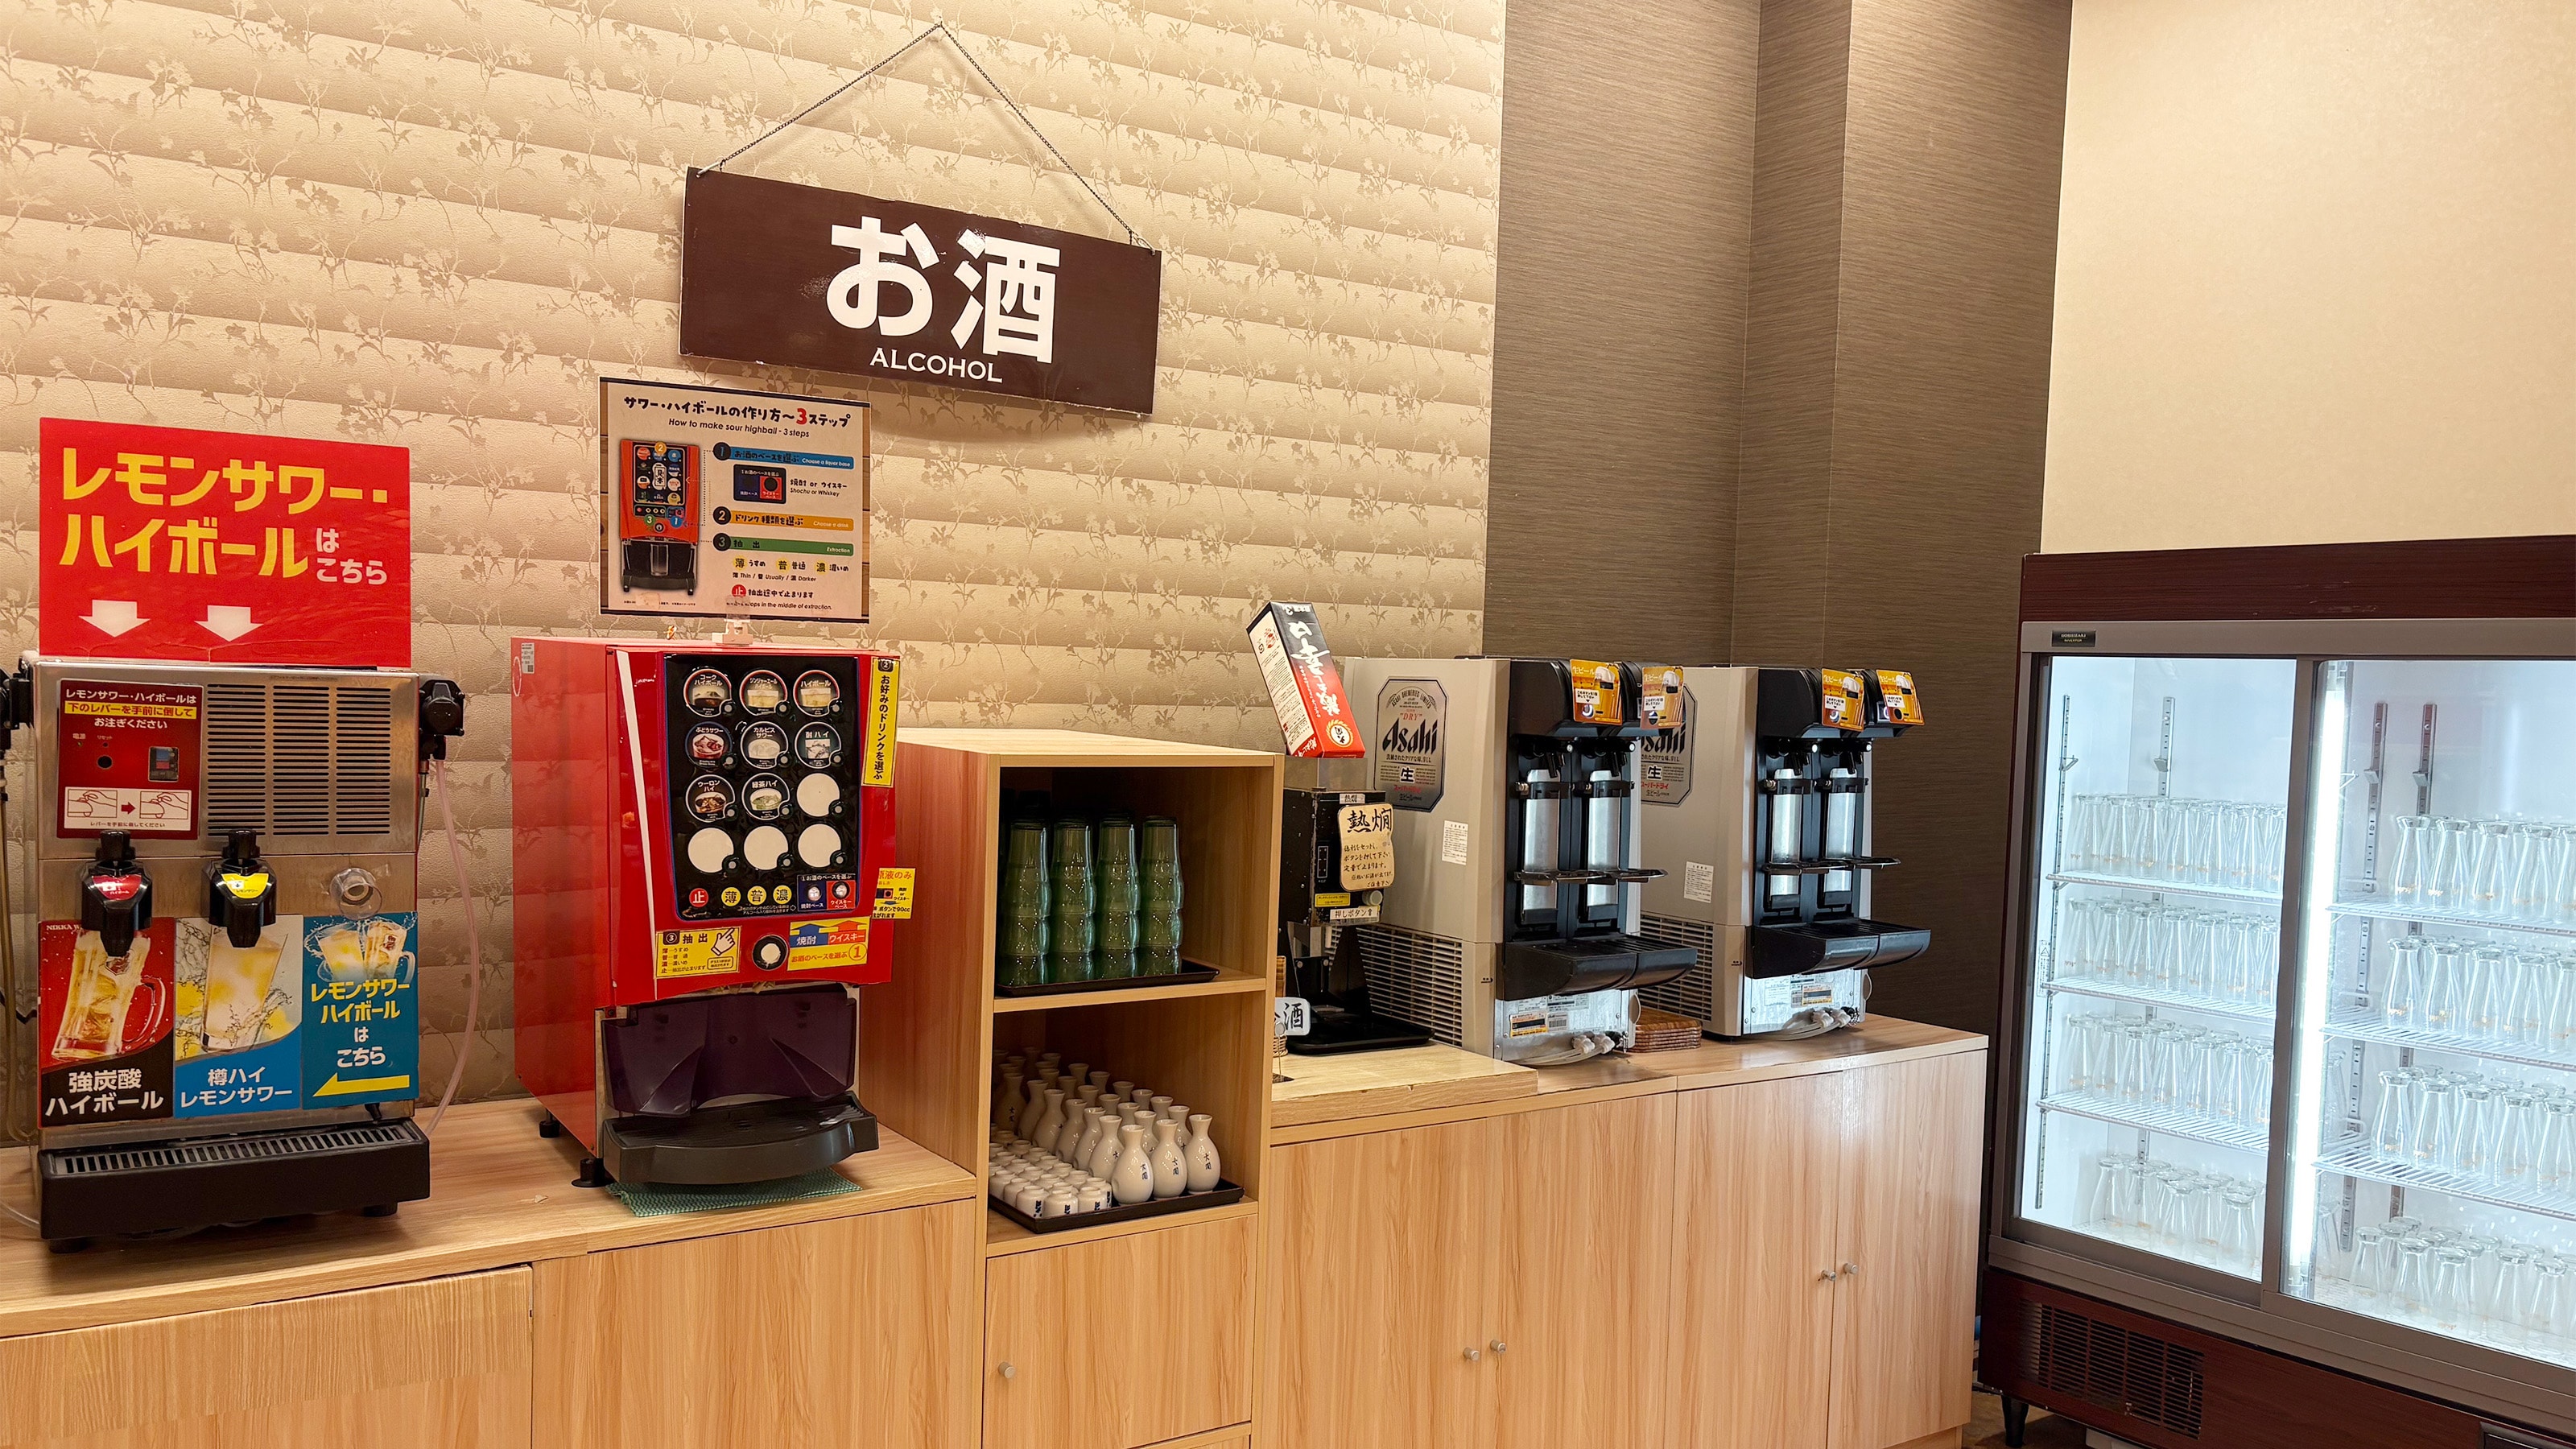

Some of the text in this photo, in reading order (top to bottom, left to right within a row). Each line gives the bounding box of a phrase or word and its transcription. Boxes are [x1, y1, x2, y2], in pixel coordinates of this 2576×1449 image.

[826, 215, 1061, 364] お酒
[870, 347, 1003, 384] ALCOHOL
[669, 419, 687, 427] How
[689, 419, 698, 427] to
[700, 421, 724, 430] make
[745, 424, 778, 435] highball
[789, 430, 810, 438] steps
[734, 451, 799, 464] お酒のベースを選ぶ
[790, 478, 807, 486] 焼酎
[821, 481, 848, 489] ウイスキー
[818, 489, 840, 497] Whiskey
[59, 514, 340, 578] ハイボール は
[735, 558, 745, 568] 薄
[778, 561, 787, 570] 普
[791, 562, 806, 570] 普通
[316, 558, 388, 585] こちら
[748, 589, 814, 599] 抽出途中で止まります
[800, 679, 832, 687] ハイボール
[66, 688, 196, 704] レモンサワー・ハイボールは
[68, 703, 193, 716] 下のレバーを手前に倒して
[94, 717, 168, 729] お注ぎください
[873, 675, 890, 780] お好みのドリンクを選ぶ
[1382, 717, 1438, 755] Asahi
[1641, 723, 1686, 754] sahi
[1401, 766, 1414, 782] 生
[1647, 766, 1662, 779] 生
[697, 780, 720, 788] ウーロン
[751, 780, 778, 789] 緑茶ハイ
[692, 890, 705, 903] 止
[724, 890, 737, 903] 薄
[750, 890, 763, 902] 普
[776, 889, 789, 901] 濃
[1335, 909, 1367, 919] 押しボタン
[796, 935, 817, 946] 焼酎
[829, 932, 865, 943] ウイスキー
[791, 952, 848, 963] お酒のベースを選ぶ
[310, 977, 410, 1002] レモンサワー
[320, 999, 401, 1024] ハイボール
[353, 1026, 369, 1043] は
[336, 1046, 386, 1068] こちら
[68, 1067, 142, 1094] 強炭酸
[208, 1066, 266, 1086] 樽ハイ
[45, 1090, 164, 1117] ハイボール
[180, 1086, 292, 1109] レモンサワー
